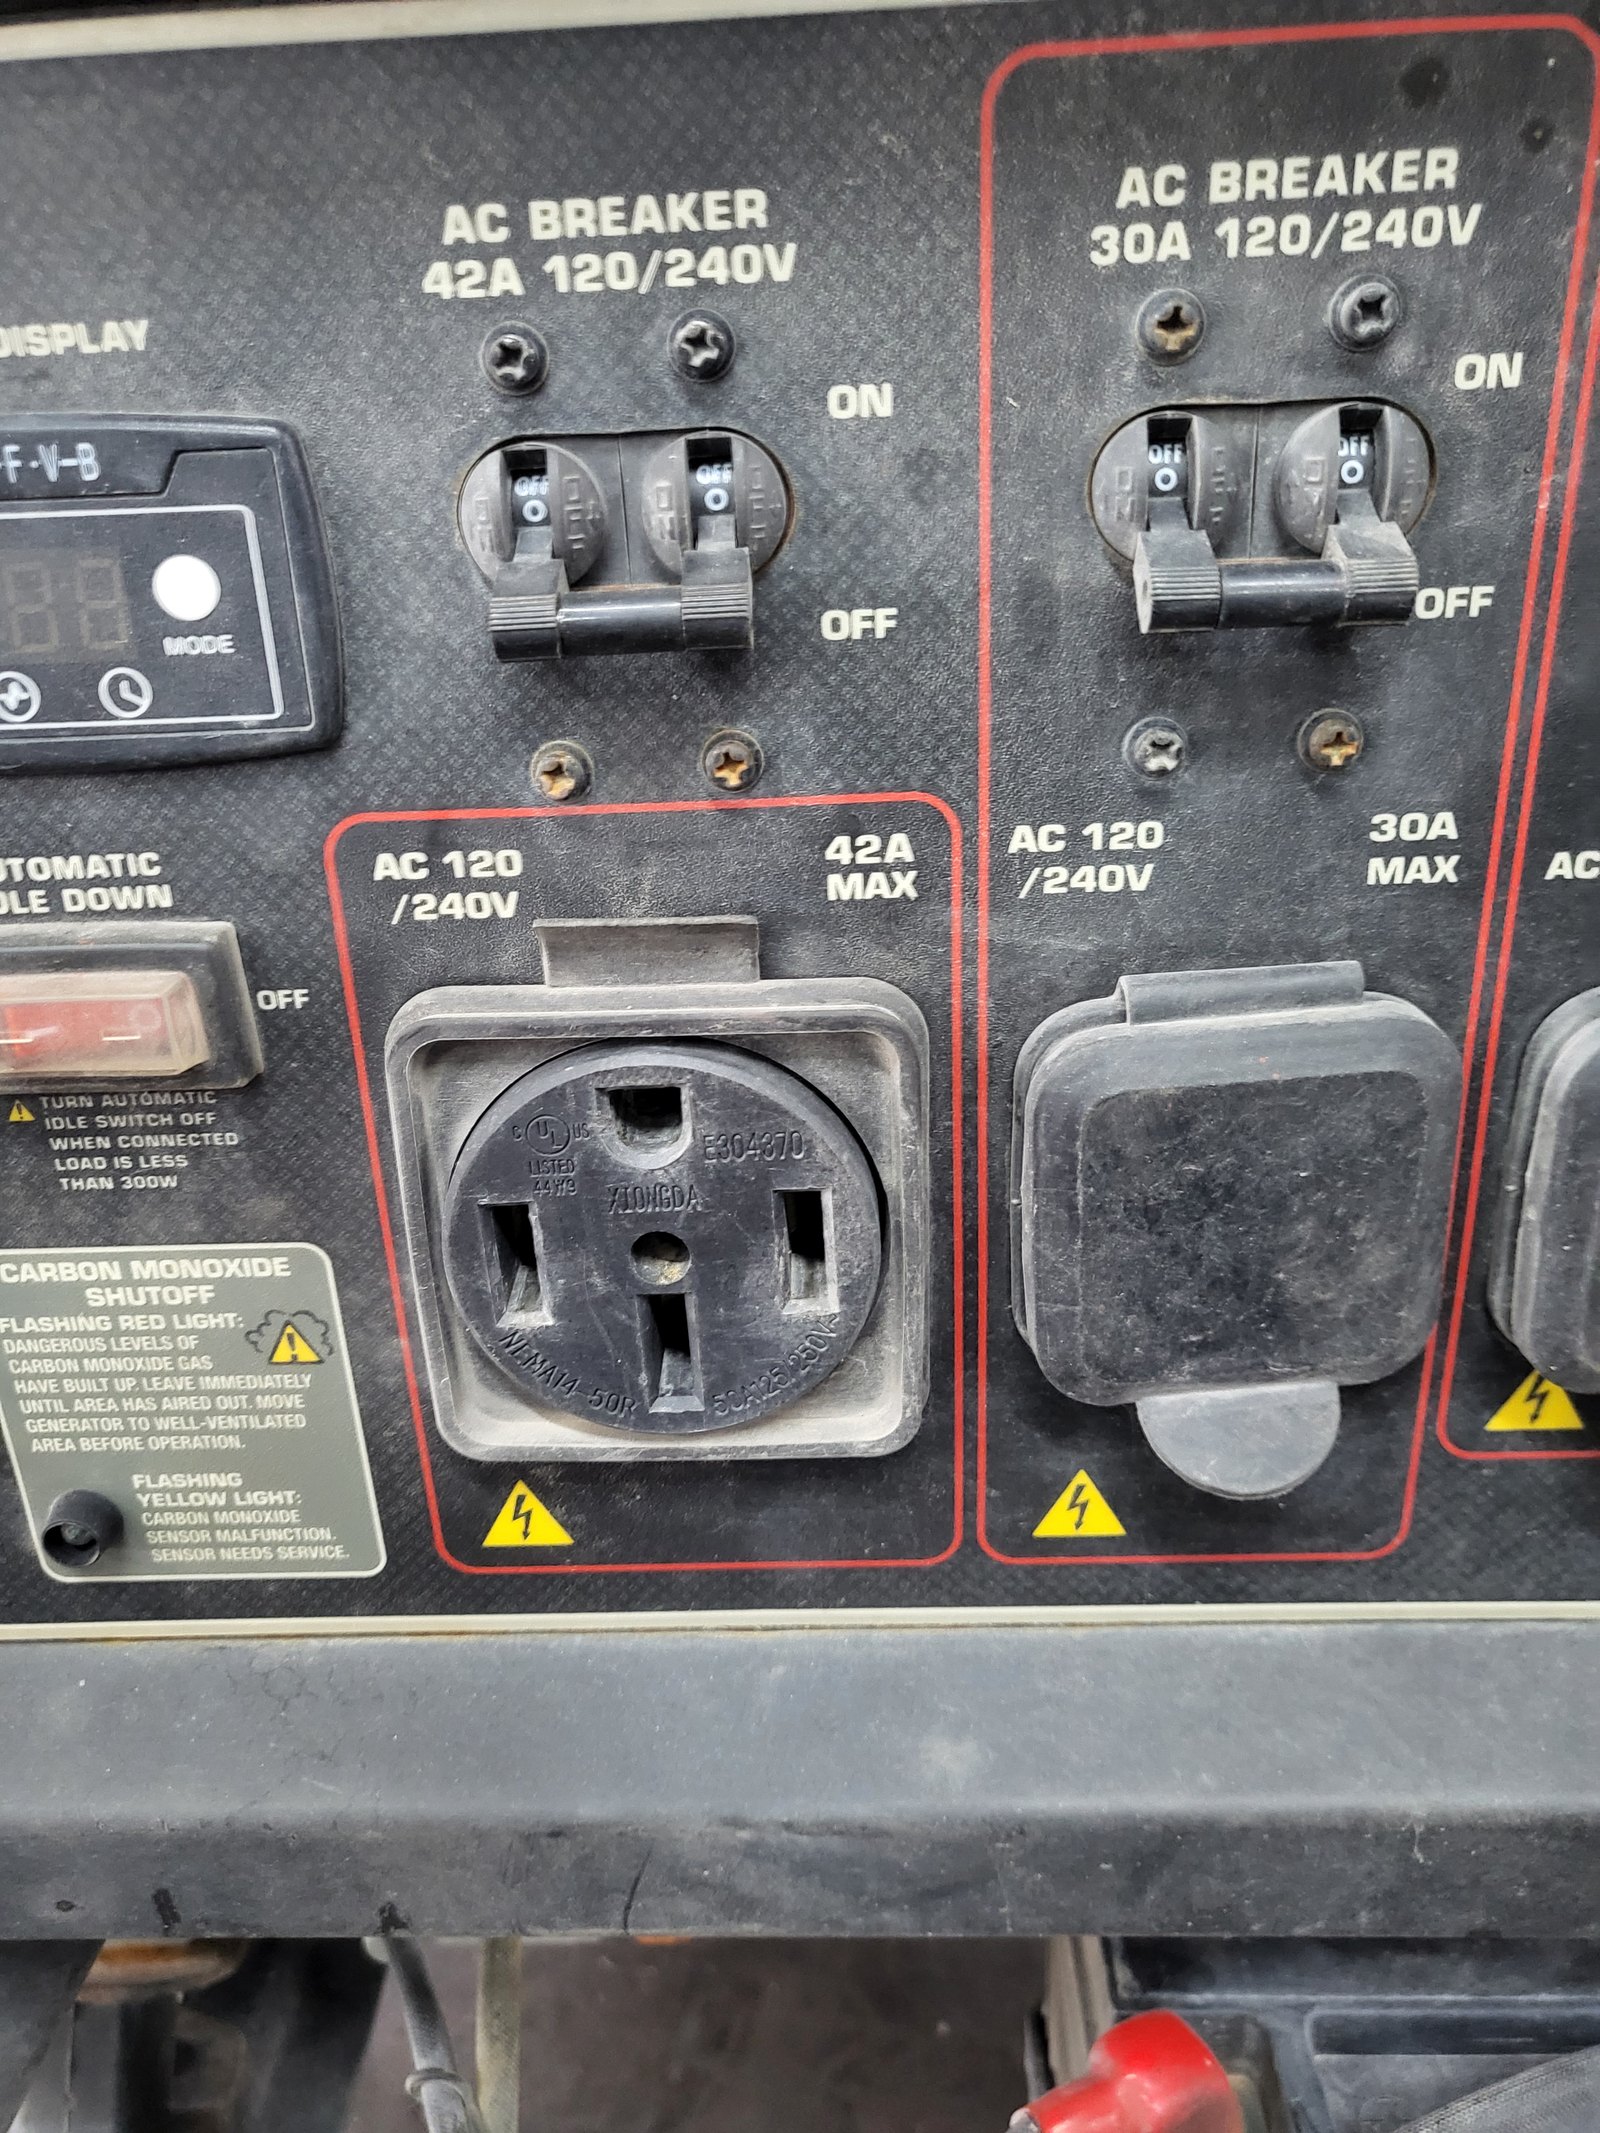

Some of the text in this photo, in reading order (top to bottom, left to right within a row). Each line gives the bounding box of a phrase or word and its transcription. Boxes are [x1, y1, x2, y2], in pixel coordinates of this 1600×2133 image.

[1116, 147, 1459, 209] AC BREAKER
[442, 189, 768, 245] AC BREAKER
[1089, 203, 1482, 267] 30A 120/240V
[421, 243, 798, 299] 42A 120/240V
[1454, 352, 1523, 390] ON
[826, 384, 894, 419] ON
[1148, 444, 1183, 465] OFF
[696, 462, 732, 485] OFF
[514, 475, 549, 496] OFF
[1414, 585, 1495, 620] OFF
[820, 608, 898, 641] OFF
[163, 635, 236, 655] MODE
[1007, 820, 1164, 855] AC 120
[1368, 812, 1459, 843] 30A
[824, 833, 915, 866] 42A
[372, 848, 523, 882] AC 120
[1366, 855, 1461, 886] MAX
[1544, 850, 1600, 880] AC
[826, 870, 919, 902] MAX
[1018, 863, 1154, 899] /240V
[61, 883, 174, 913] DOWN
[391, 891, 519, 925] /240V
[256, 989, 310, 1011] OFF
[39, 1091, 218, 1110] TURN AUTOMATIC
[45, 1112, 217, 1130] IDLE SWITCH OFF
[49, 1132, 239, 1151] WHEN CONNECTED
[703, 1131, 805, 1163] E304370
[54, 1154, 189, 1171] LOAD IS LESS
[529, 1159, 575, 1177] LISTED
[59, 1175, 179, 1191] THAN 300W
[607, 1184, 702, 1214] XIONGDA
[0, 1256, 292, 1283] CARBON MONOXIDE
[85, 1285, 215, 1307] SHUTOFF
[0, 1312, 244, 1333] FLASHING RED LIGHT:
[2, 1334, 200, 1354] DANGEROUS LEVELS OF
[8, 1355, 214, 1374] CARBON MONOXIDE GAS
[14, 1378, 60, 1394] HAVE
[62, 1377, 109, 1393] BUILT
[142, 1376, 197, 1391] LEAVE
[200, 1373, 312, 1390] IMMEDIATELY
[19, 1399, 70, 1414] UNTIL
[73, 1398, 119, 1413] AREA
[122, 1396, 158, 1412] HAS
[161, 1395, 212, 1411] AIRED
[255, 1393, 306, 1409] MOVE
[25, 1413, 307, 1433] GENERATOR TO WELL-VENTILATED
[32, 1434, 246, 1453] AREA BEFORE OPERATION.
[132, 1472, 243, 1488] FLASHING
[136, 1490, 302, 1508] YELLOW LIGHT:
[142, 1509, 301, 1526] CARBON MONOXIDE
[146, 1527, 337, 1544] SENSOR MALFUNCTION.
[151, 1544, 350, 1562] SENSOR NEEDS SERVICE.
